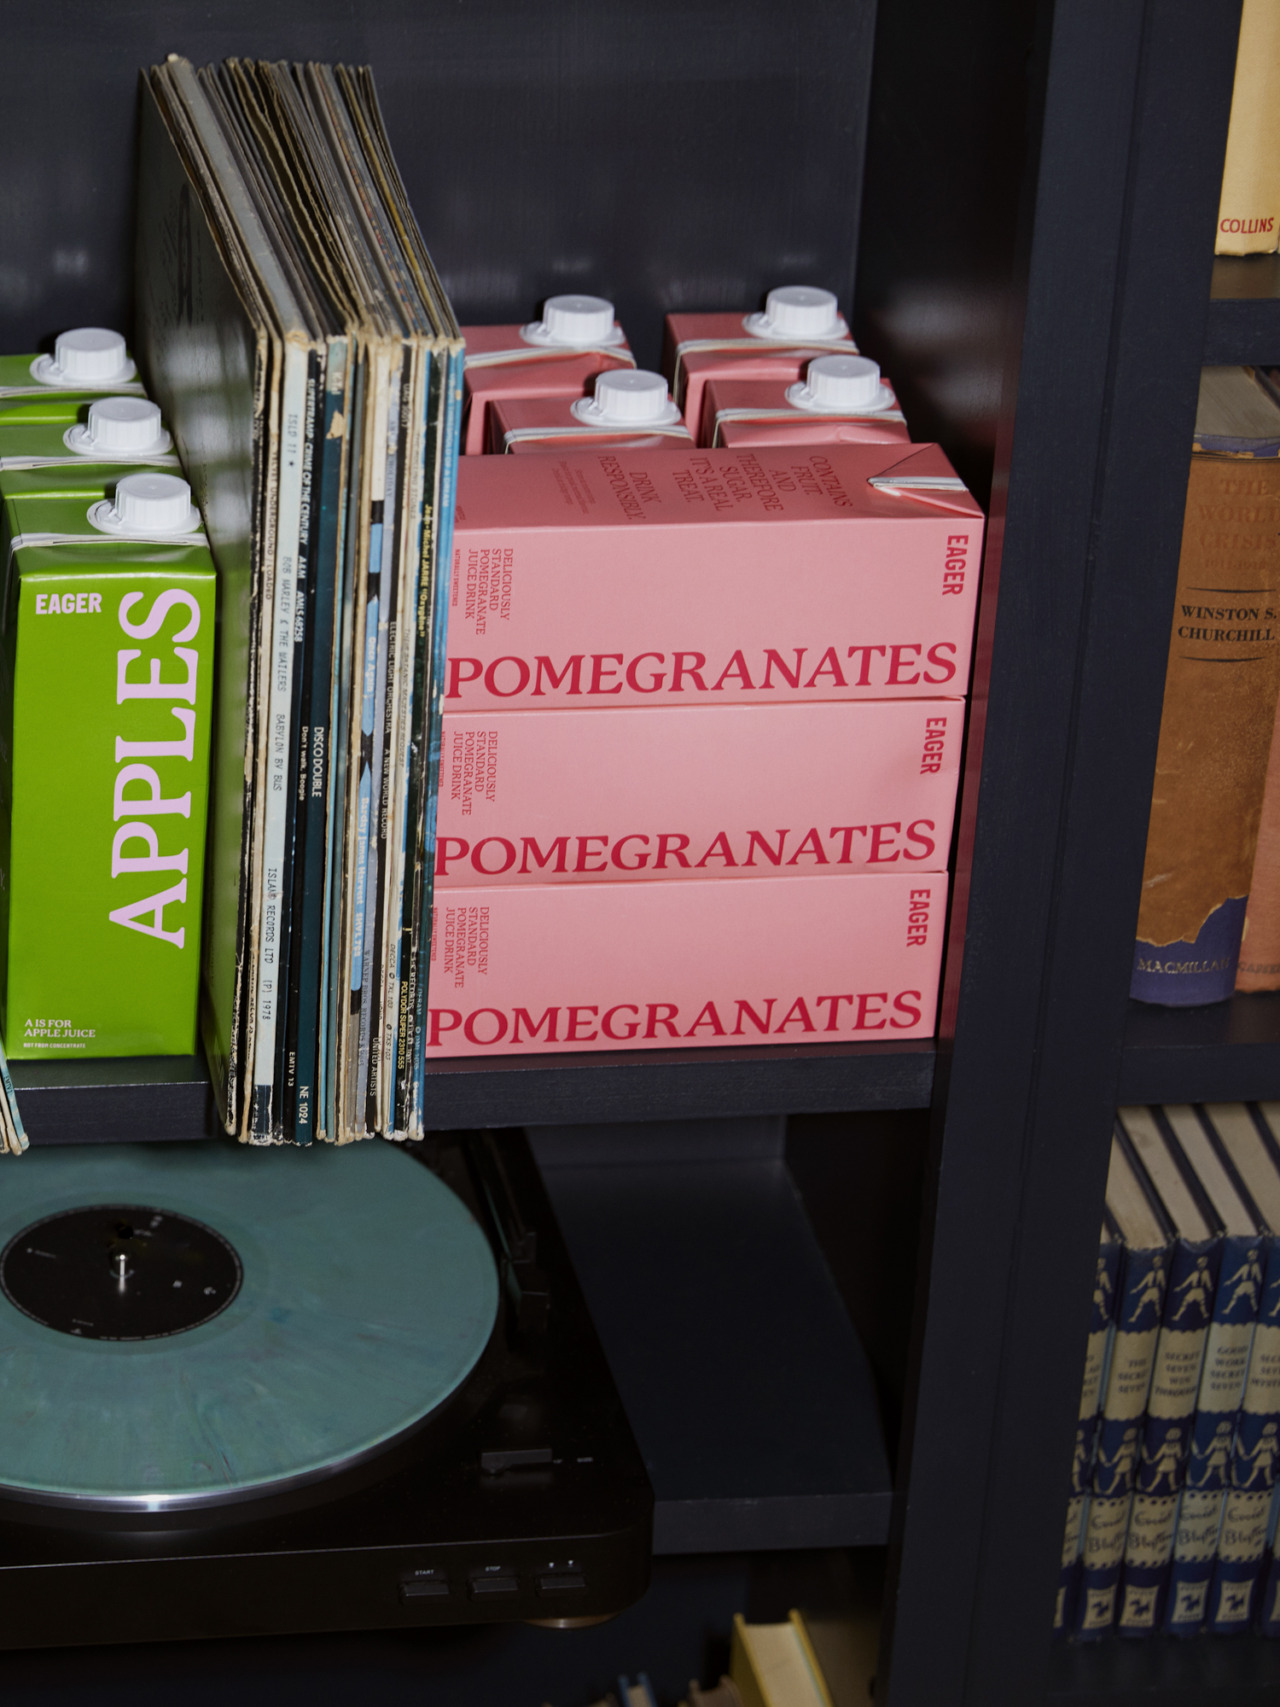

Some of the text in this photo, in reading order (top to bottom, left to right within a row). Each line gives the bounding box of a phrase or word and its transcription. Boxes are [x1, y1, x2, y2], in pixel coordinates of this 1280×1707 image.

[1220, 217, 1274, 234] COLLINS
[597, 455, 646, 521] RESPONSIBLY.
[629, 471, 663, 504] DRINK
[672, 469, 705, 504] TREAT.
[719, 466, 752, 503] SUGAR.
[736, 453, 784, 512] THEREFORE
[769, 468, 798, 493] AND
[790, 464, 823, 497] FRUIT.
[808, 455, 853, 508] CONTAINS
[421, 504, 433, 558] Jean-Michel
[282, 556, 292, 574] BOB
[297, 555, 308, 579] A&M
[419, 559, 430, 587] JARRE
[464, 549, 479, 619] JUICE DRINK
[488, 548, 502, 611] STANDARD
[500, 548, 514, 620] DELICIOUSLY
[941, 533, 970, 597] EAGER
[36, 592, 102, 615] EAGER
[280, 578, 292, 614] MARLEY
[295, 590, 306, 616] AMLS
[475, 548, 490, 635] POMEGRANATE
[1181, 604, 1277, 621] WINSTON S.
[279, 630, 290, 647] THE
[1177, 626, 1274, 642] CHURCHILL
[277, 651, 289, 692] WAILERS
[384, 621, 398, 735] ELECTRIC LIGHT ORCHESTRA
[445, 642, 958, 700] POMEGRANATES
[272, 714, 286, 792] BABYLON BY BUS
[311, 727, 325, 798] DISCO DOUBLE
[450, 731, 464, 800] JUICE DRINK
[475, 731, 487, 793] STANDARD
[919, 717, 948, 775] EAGER
[108, 587, 201, 950] APPLES
[383, 757, 391, 775] NEW
[462, 731, 476, 815] POMEGRANATE
[486, 731, 498, 802] DELICIOUSLY
[296, 774, 307, 802] Boogie
[382, 777, 390, 806] WORLD
[357, 835, 368, 865] James
[433, 819, 936, 877] POMEGRANATES
[355, 867, 366, 905] Harvest
[265, 905, 277, 943] RECORDS
[466, 906, 479, 966] STANDARD
[906, 888, 932, 948] EAGER
[264, 948, 276, 964] LTD
[388, 944, 397, 968] DECCA
[443, 906, 456, 974] JUICE DRINK
[454, 906, 467, 988] POMEGRANATE
[477, 906, 490, 975] DELICIOUSLY
[1137, 957, 1231, 974] MACMILLAN
[24, 1018, 72, 1028] A IS FOR
[261, 1000, 273, 1020] 1978
[397, 981, 410, 1070] POLYDOR SUPER 2310 555
[426, 990, 923, 1049] POMEGRANATES
[24, 1029, 96, 1038] APPLE JUICE
[287, 1051, 297, 1087] EMTV 13
[369, 1037, 381, 1097] UNITED ARTISTS
[298, 1085, 311, 1124] NE 1024
[484, 1565, 502, 1573] STOP
